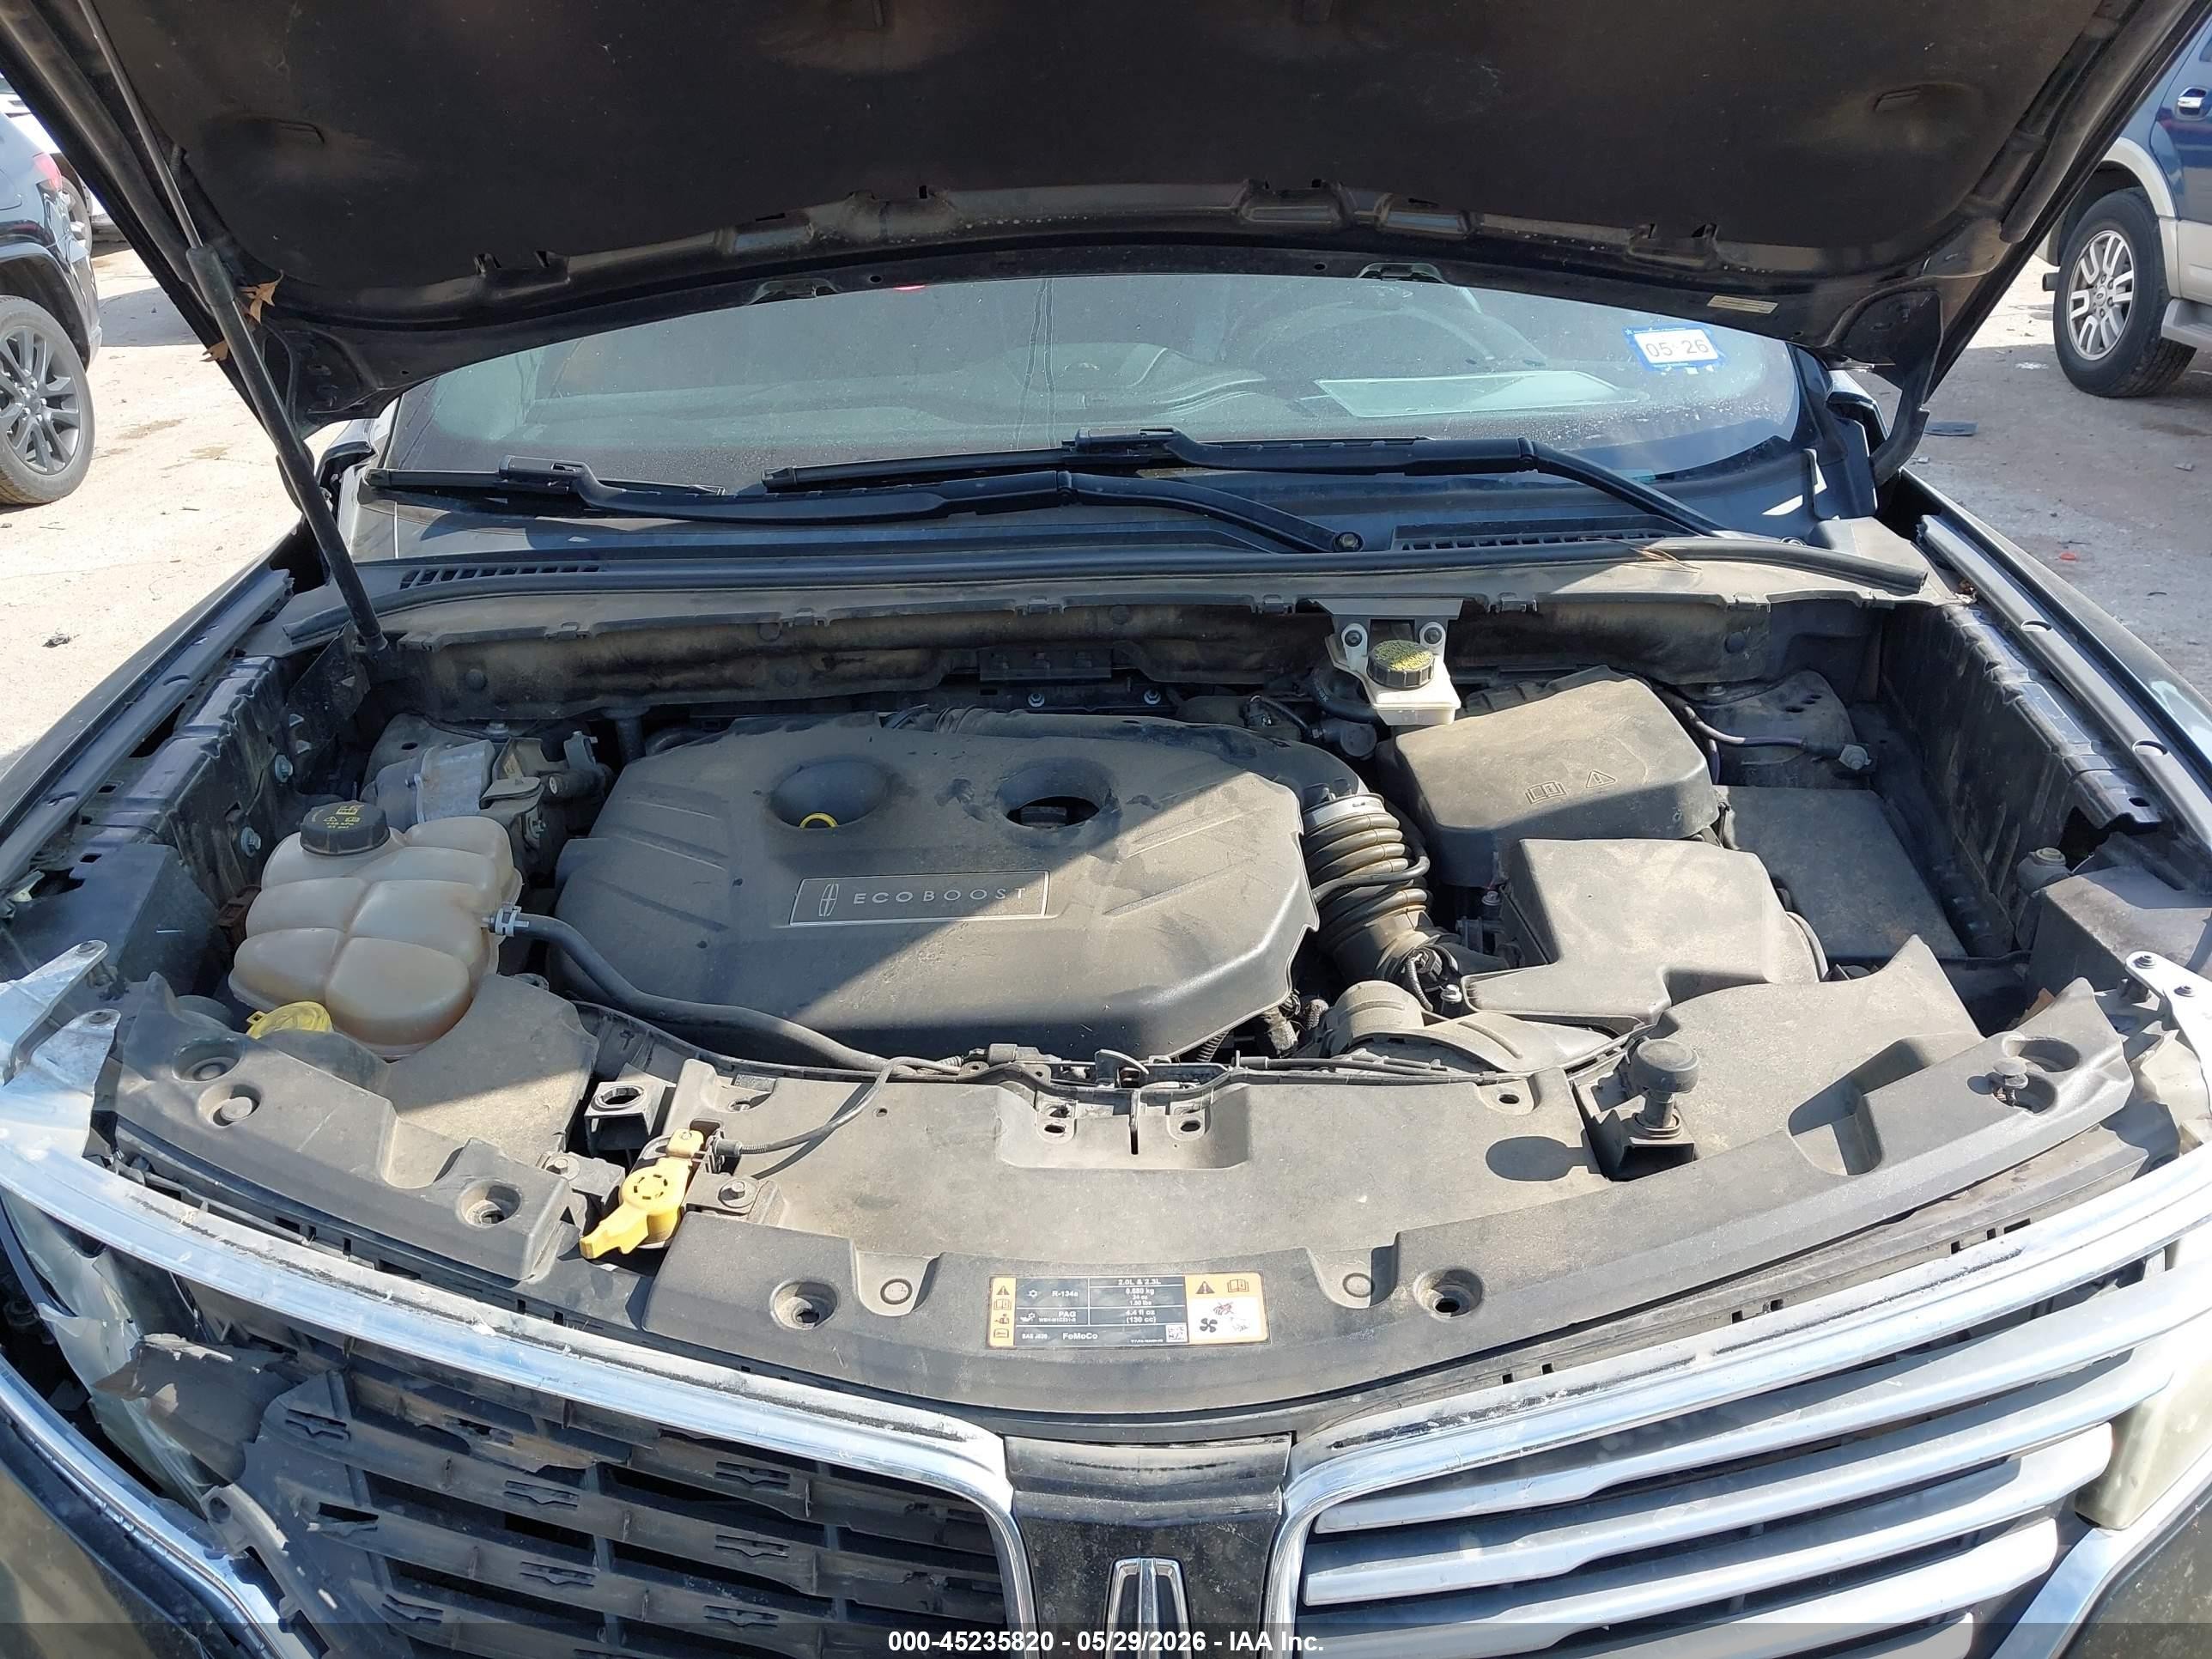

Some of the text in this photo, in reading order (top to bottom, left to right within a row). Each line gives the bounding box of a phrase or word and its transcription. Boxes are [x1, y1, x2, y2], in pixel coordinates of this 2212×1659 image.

[1645, 339, 1709, 357] 05 26
[854, 887, 1027, 905] ECOBOOST
